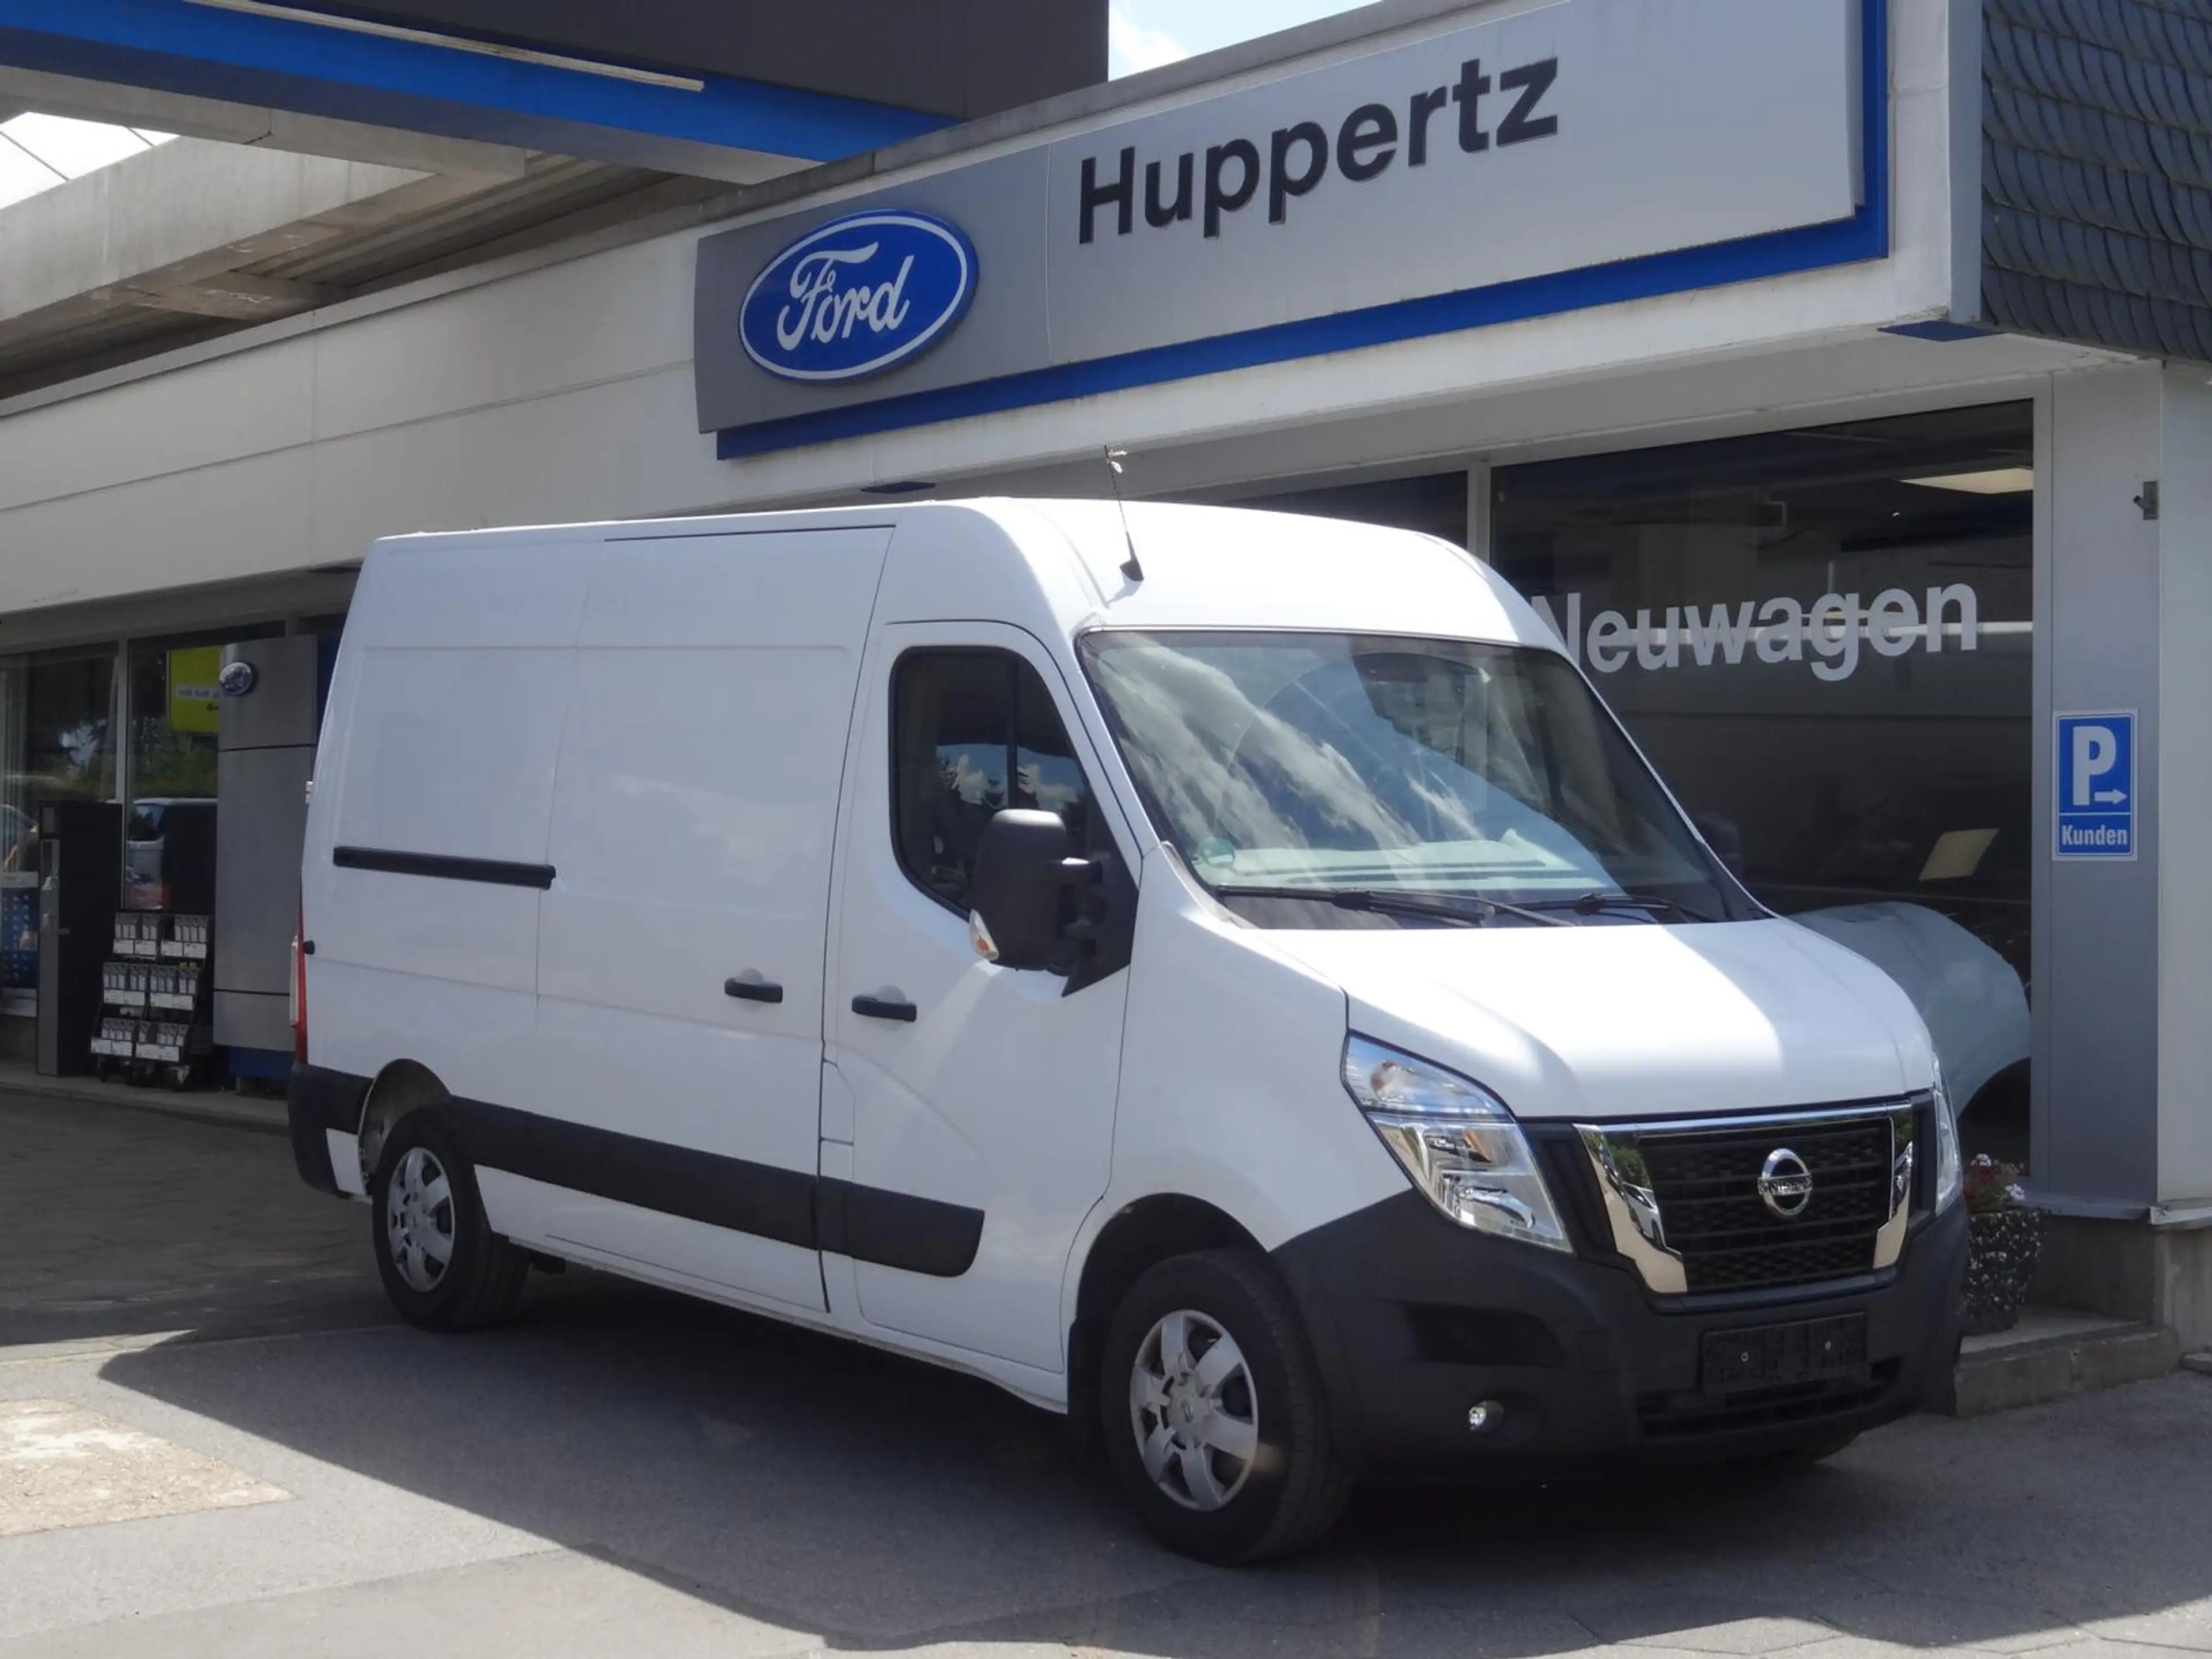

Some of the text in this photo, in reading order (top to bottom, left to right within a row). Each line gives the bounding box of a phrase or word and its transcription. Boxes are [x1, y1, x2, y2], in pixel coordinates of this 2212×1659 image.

[1080, 56, 1558, 245] Huppertz
[777, 241, 915, 351] Ford
[2073, 726, 2116, 805] P
[2061, 825, 2127, 846] Kunden
